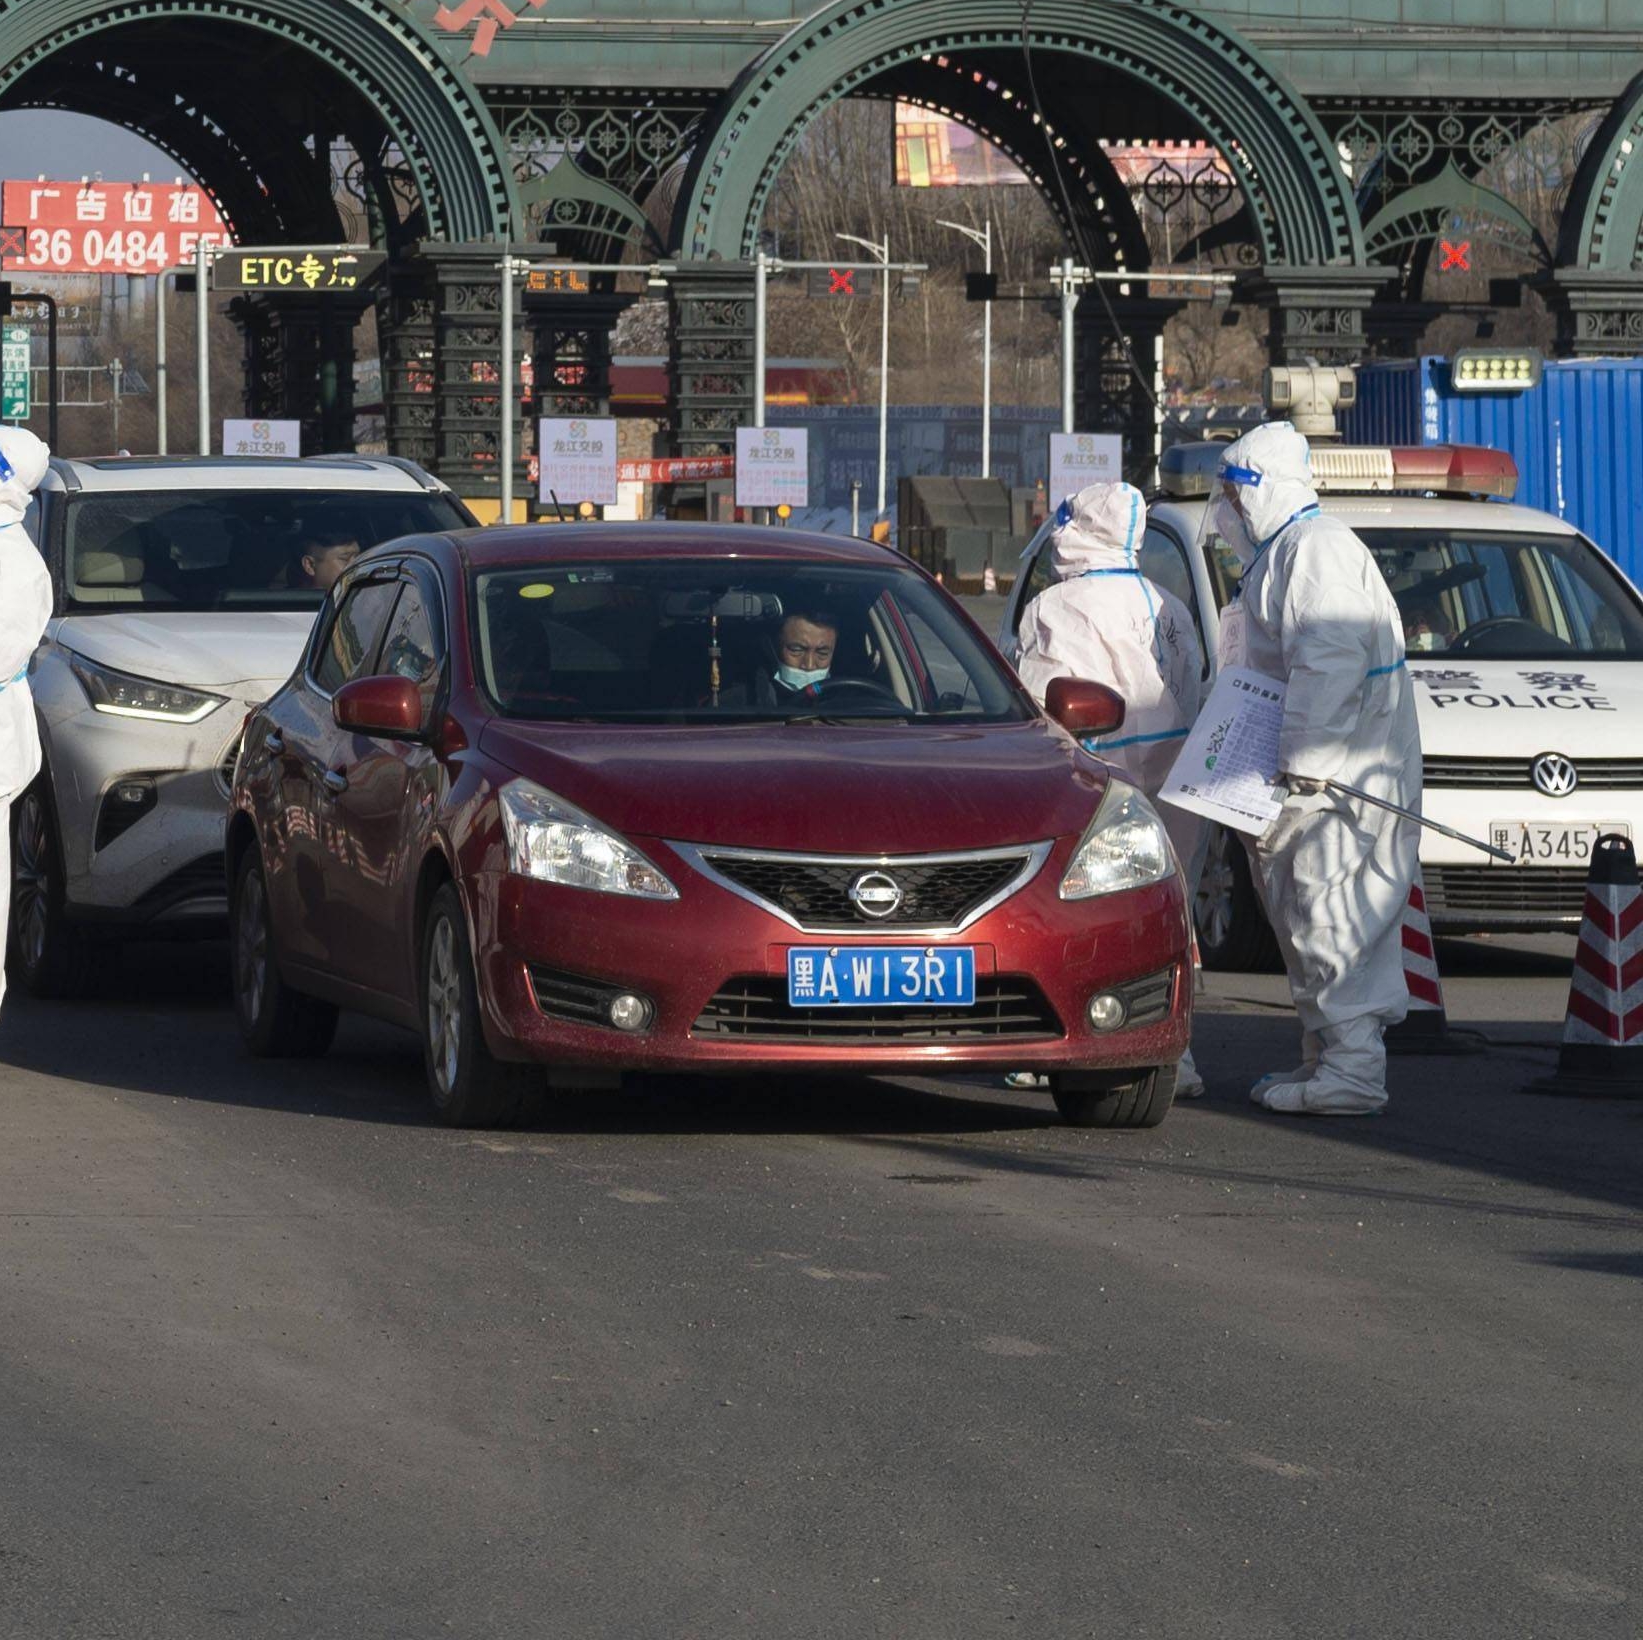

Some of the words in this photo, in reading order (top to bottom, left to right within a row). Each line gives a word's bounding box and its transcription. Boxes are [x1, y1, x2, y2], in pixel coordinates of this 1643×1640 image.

[30, 189, 222, 224] 广告位招
[16, 228, 71, 265] 36
[83, 229, 168, 267] 0484
[1429, 694, 1618, 712] POLICE
